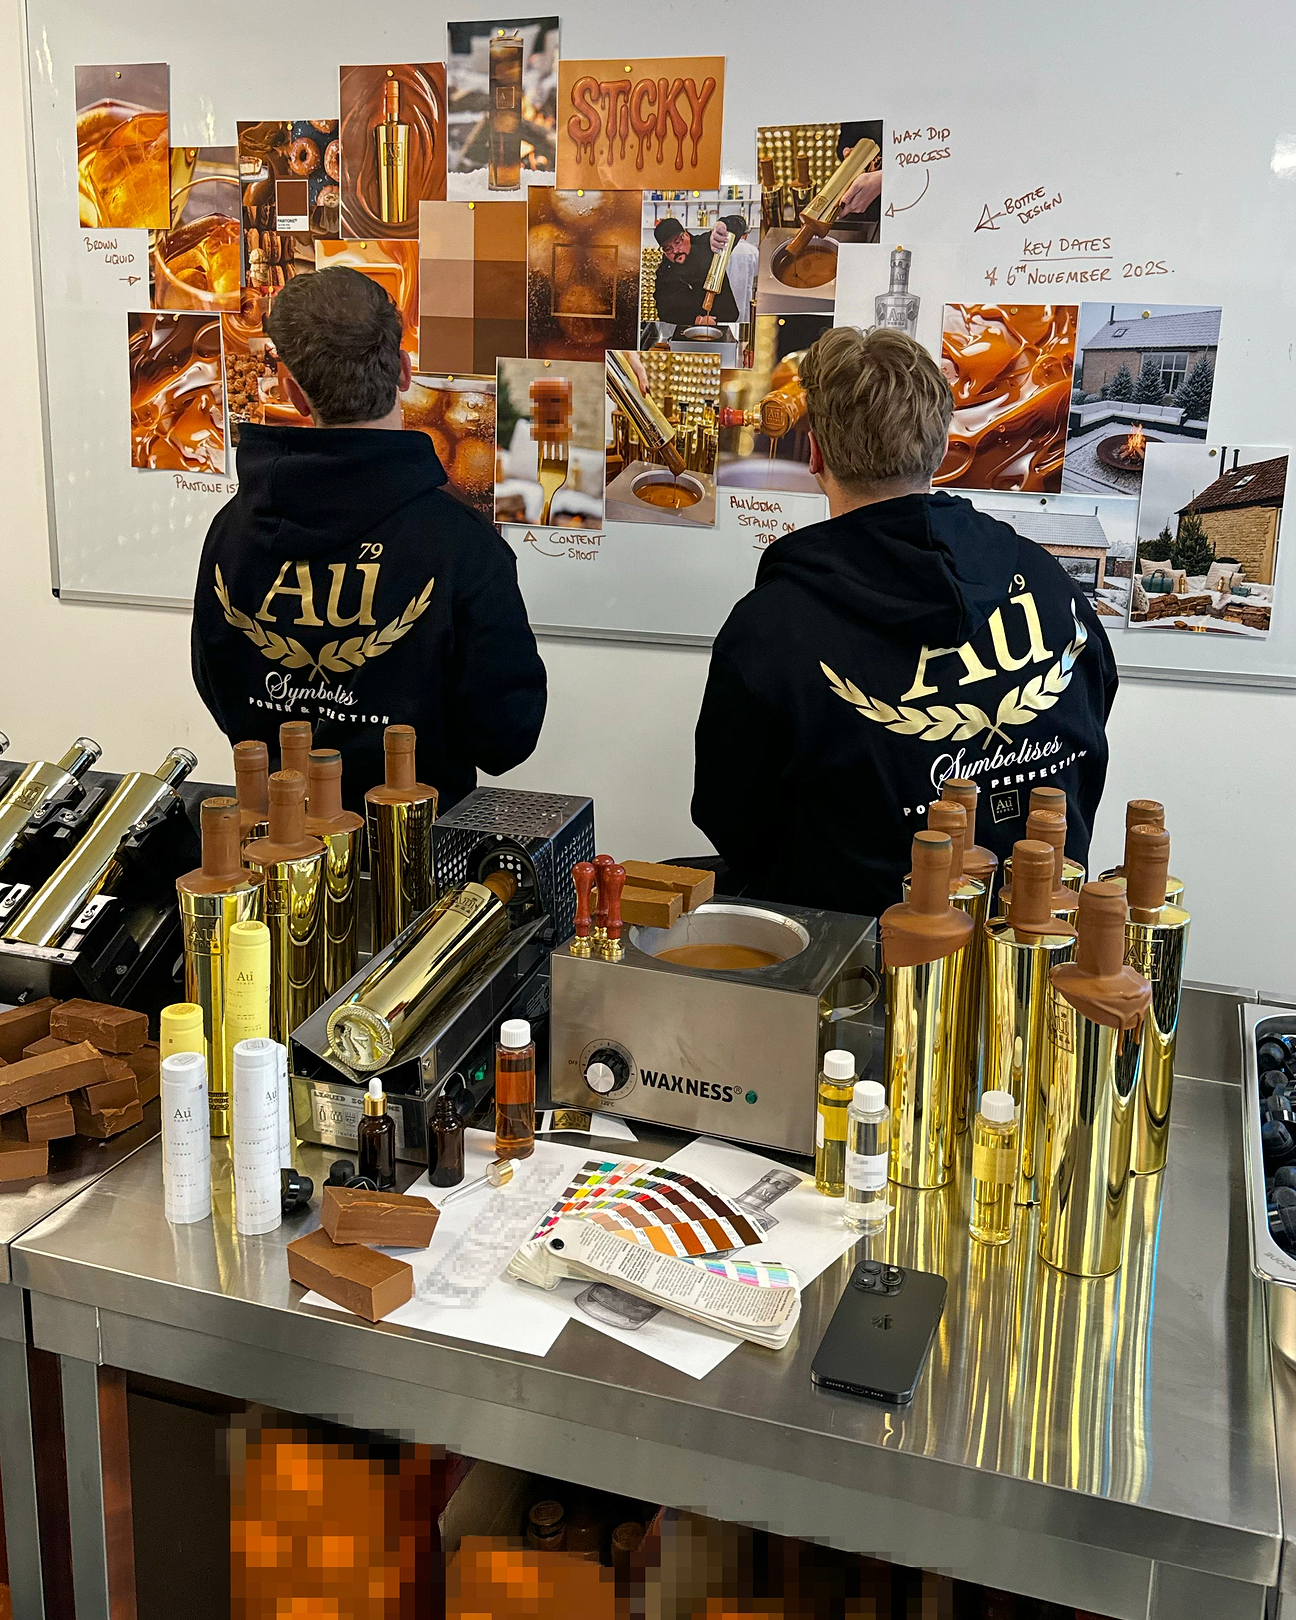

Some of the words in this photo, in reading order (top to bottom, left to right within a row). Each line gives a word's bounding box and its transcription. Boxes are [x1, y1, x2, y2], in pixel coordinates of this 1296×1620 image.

[893, 128, 922, 144] WAX
[926, 127, 951, 142] DIP
[896, 147, 951, 168] PROCESS
[1004, 186, 1046, 215] BOTTLE
[1017, 193, 1063, 224] DESIGN
[83, 236, 118, 252] BROWN
[1023, 238, 1052, 257] KEY
[1059, 237, 1111, 252] DATES
[1027, 268, 1112, 285] NOVEMBER
[173, 474, 222, 493] PANTONE
[737, 514, 778, 531] STAMP
[782, 522, 796, 533] ON
[549, 532, 606, 546] CONTENT
[754, 533, 777, 544] TOP
[358, 543, 383, 560] 79
[568, 548, 599, 560] SHOOT
[173, 1107, 192, 1119] Au
